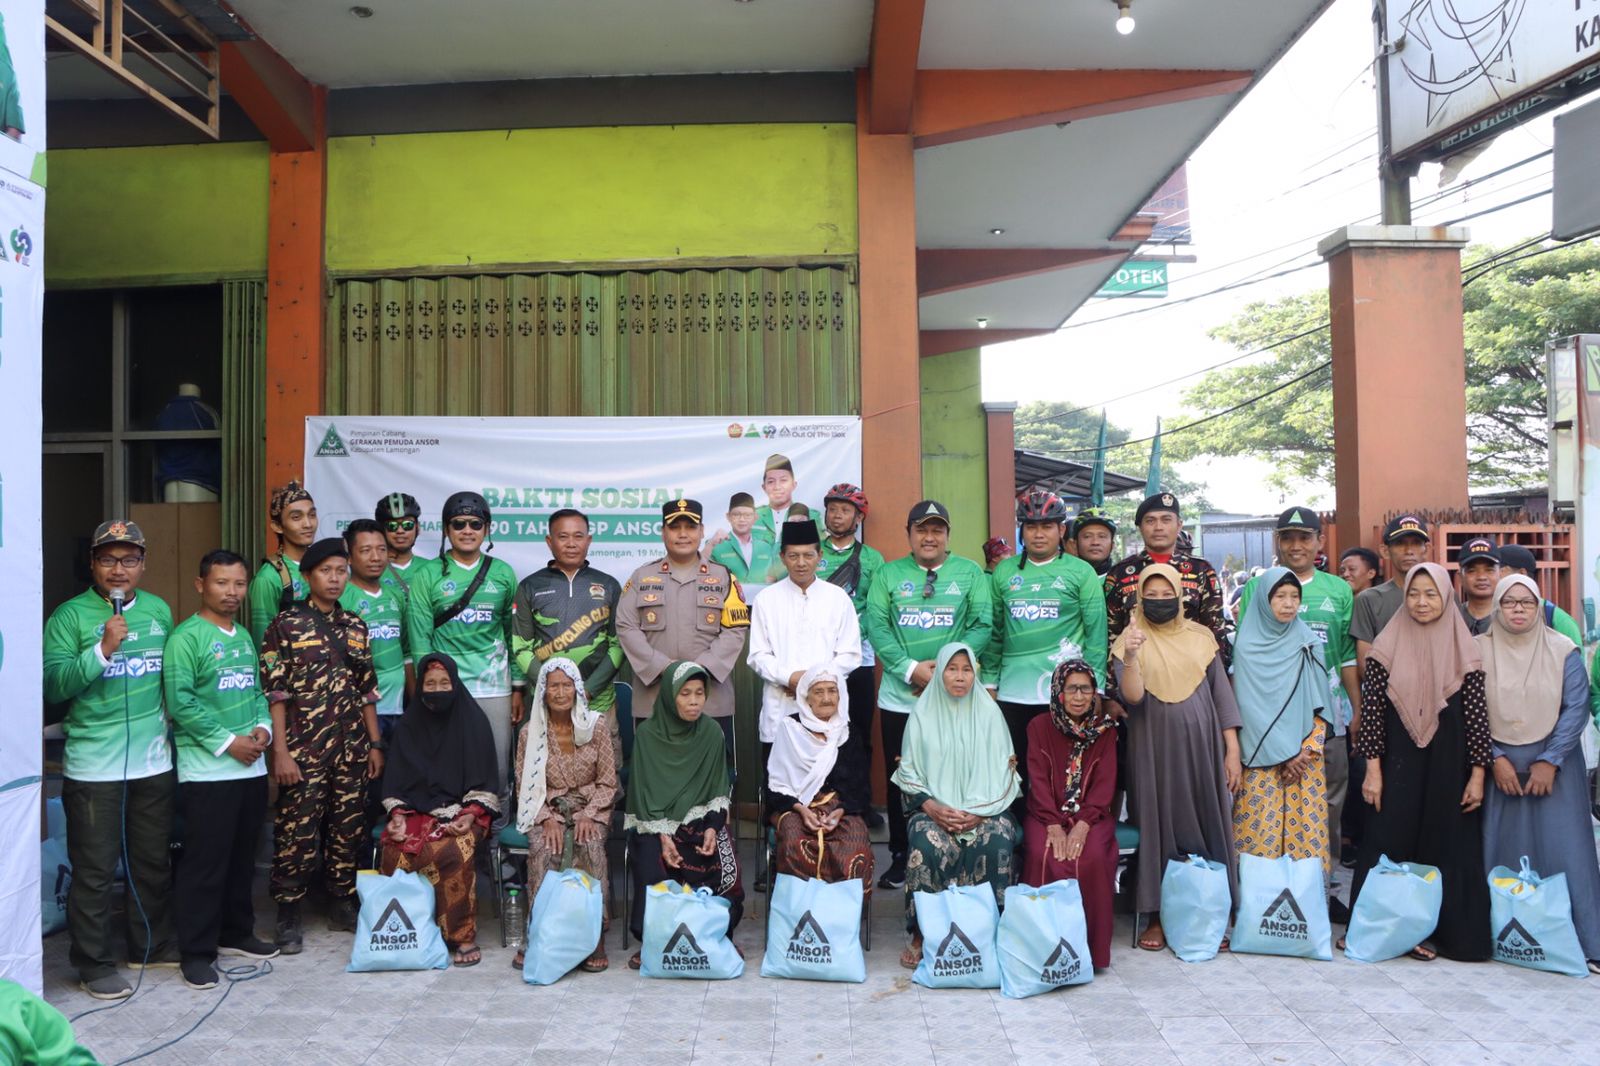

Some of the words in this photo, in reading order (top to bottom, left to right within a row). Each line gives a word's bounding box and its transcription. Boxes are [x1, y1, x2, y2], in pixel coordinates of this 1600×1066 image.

[1114, 269, 1165, 284] OTEK
[382, 430, 406, 438] Cabang
[386, 446, 421, 455] Lamongan
[482, 487, 574, 508] BAKTI
[515, 521, 550, 535] TAH
[613, 521, 663, 536] ANSO
[587, 549, 634, 559] amongan,
[698, 585, 723, 593] POLRI
[730, 607, 748, 622] WAKA
[554, 615, 592, 651] CYCLING
[1259, 918, 1308, 934] ANSOR
[370, 931, 418, 945] ANSOR
[1259, 930, 1308, 940] LAMONGAN
[370, 943, 419, 952] LAMONGAN
[787, 942, 831, 957] ANSOR
[1496, 942, 1544, 956] ANSOR
[662, 955, 709, 965] ANSOR
[786, 952, 832, 963] LAMONGAN
[933, 956, 983, 970] ANSOR
[933, 967, 983, 977] LAMONGAN
[1041, 960, 1081, 981] ANSOR
